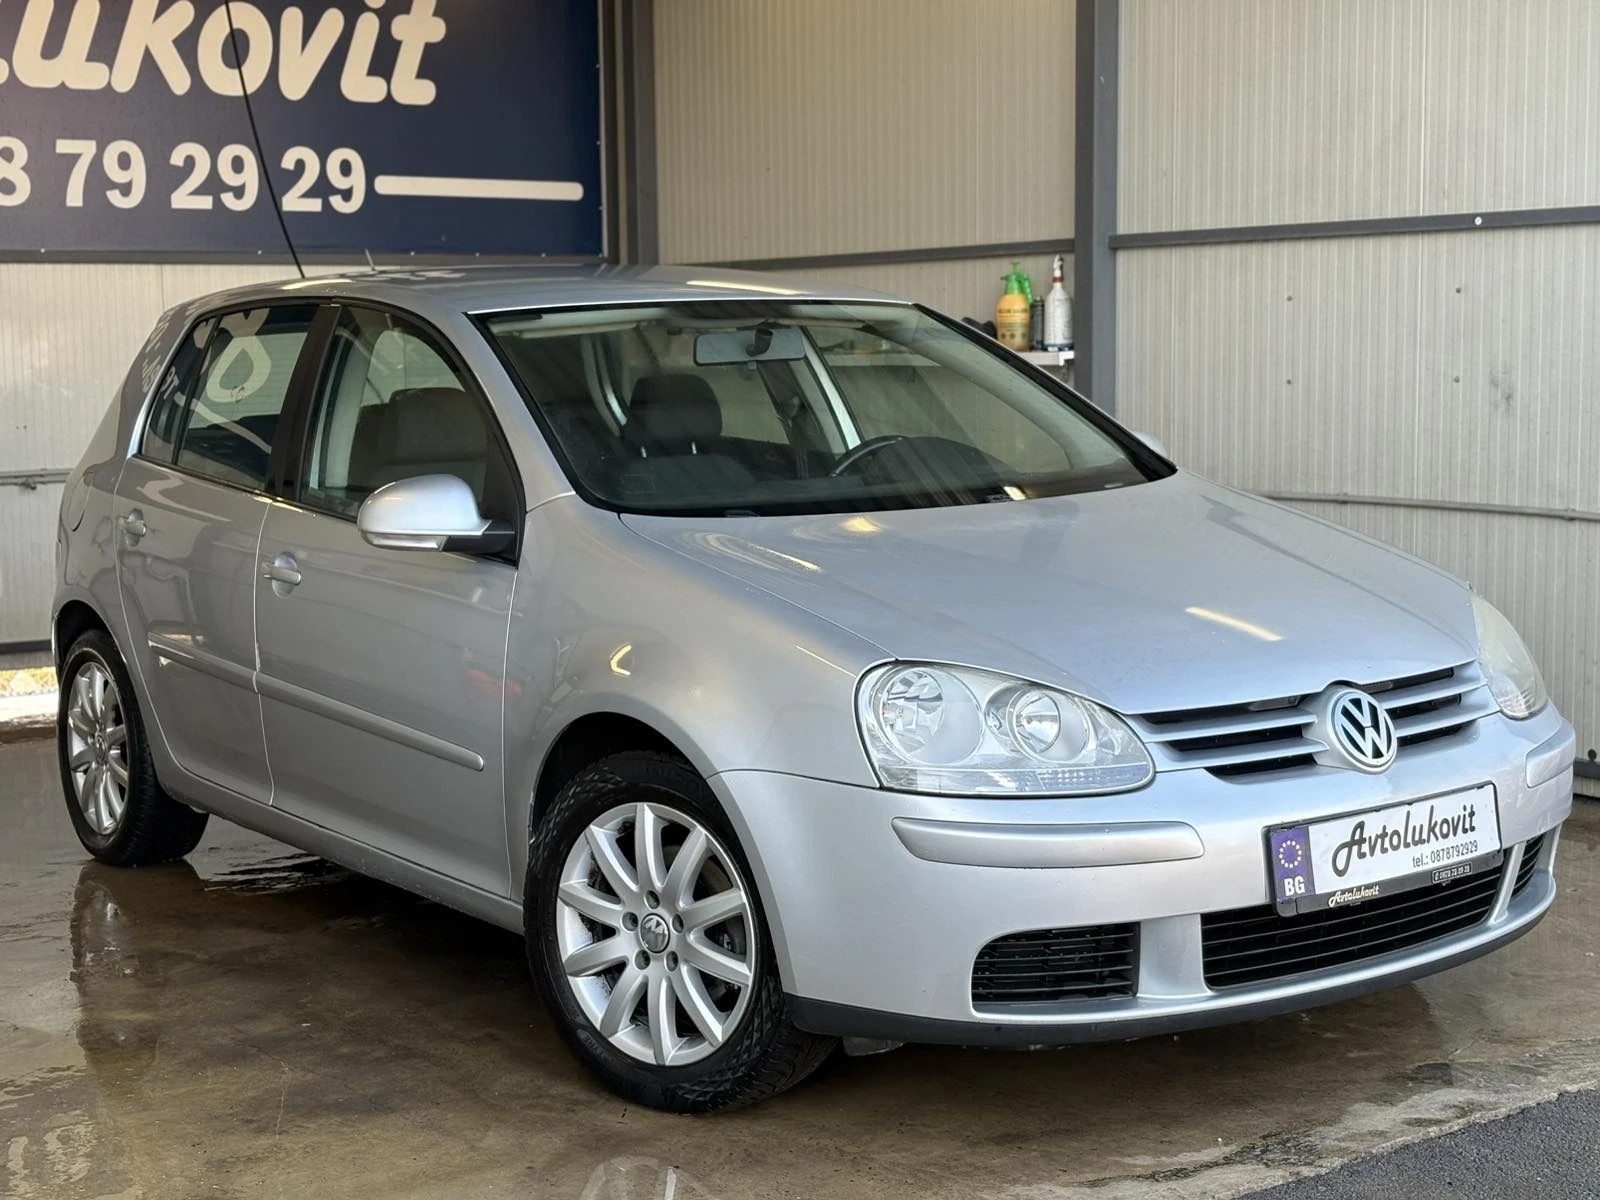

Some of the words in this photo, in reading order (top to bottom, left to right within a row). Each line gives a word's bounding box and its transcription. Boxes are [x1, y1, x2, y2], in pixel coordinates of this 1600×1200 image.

[0, 0, 446, 105] ukovit
[55, 138, 147, 209] 79
[169, 142, 260, 211] 29
[280, 146, 367, 214] 29
[1334, 691, 1394, 768] VW
[1331, 804, 1476, 877] Avtolukovit
[1430, 840, 1478, 863] 0878792929
[1283, 875, 1306, 897] BG
